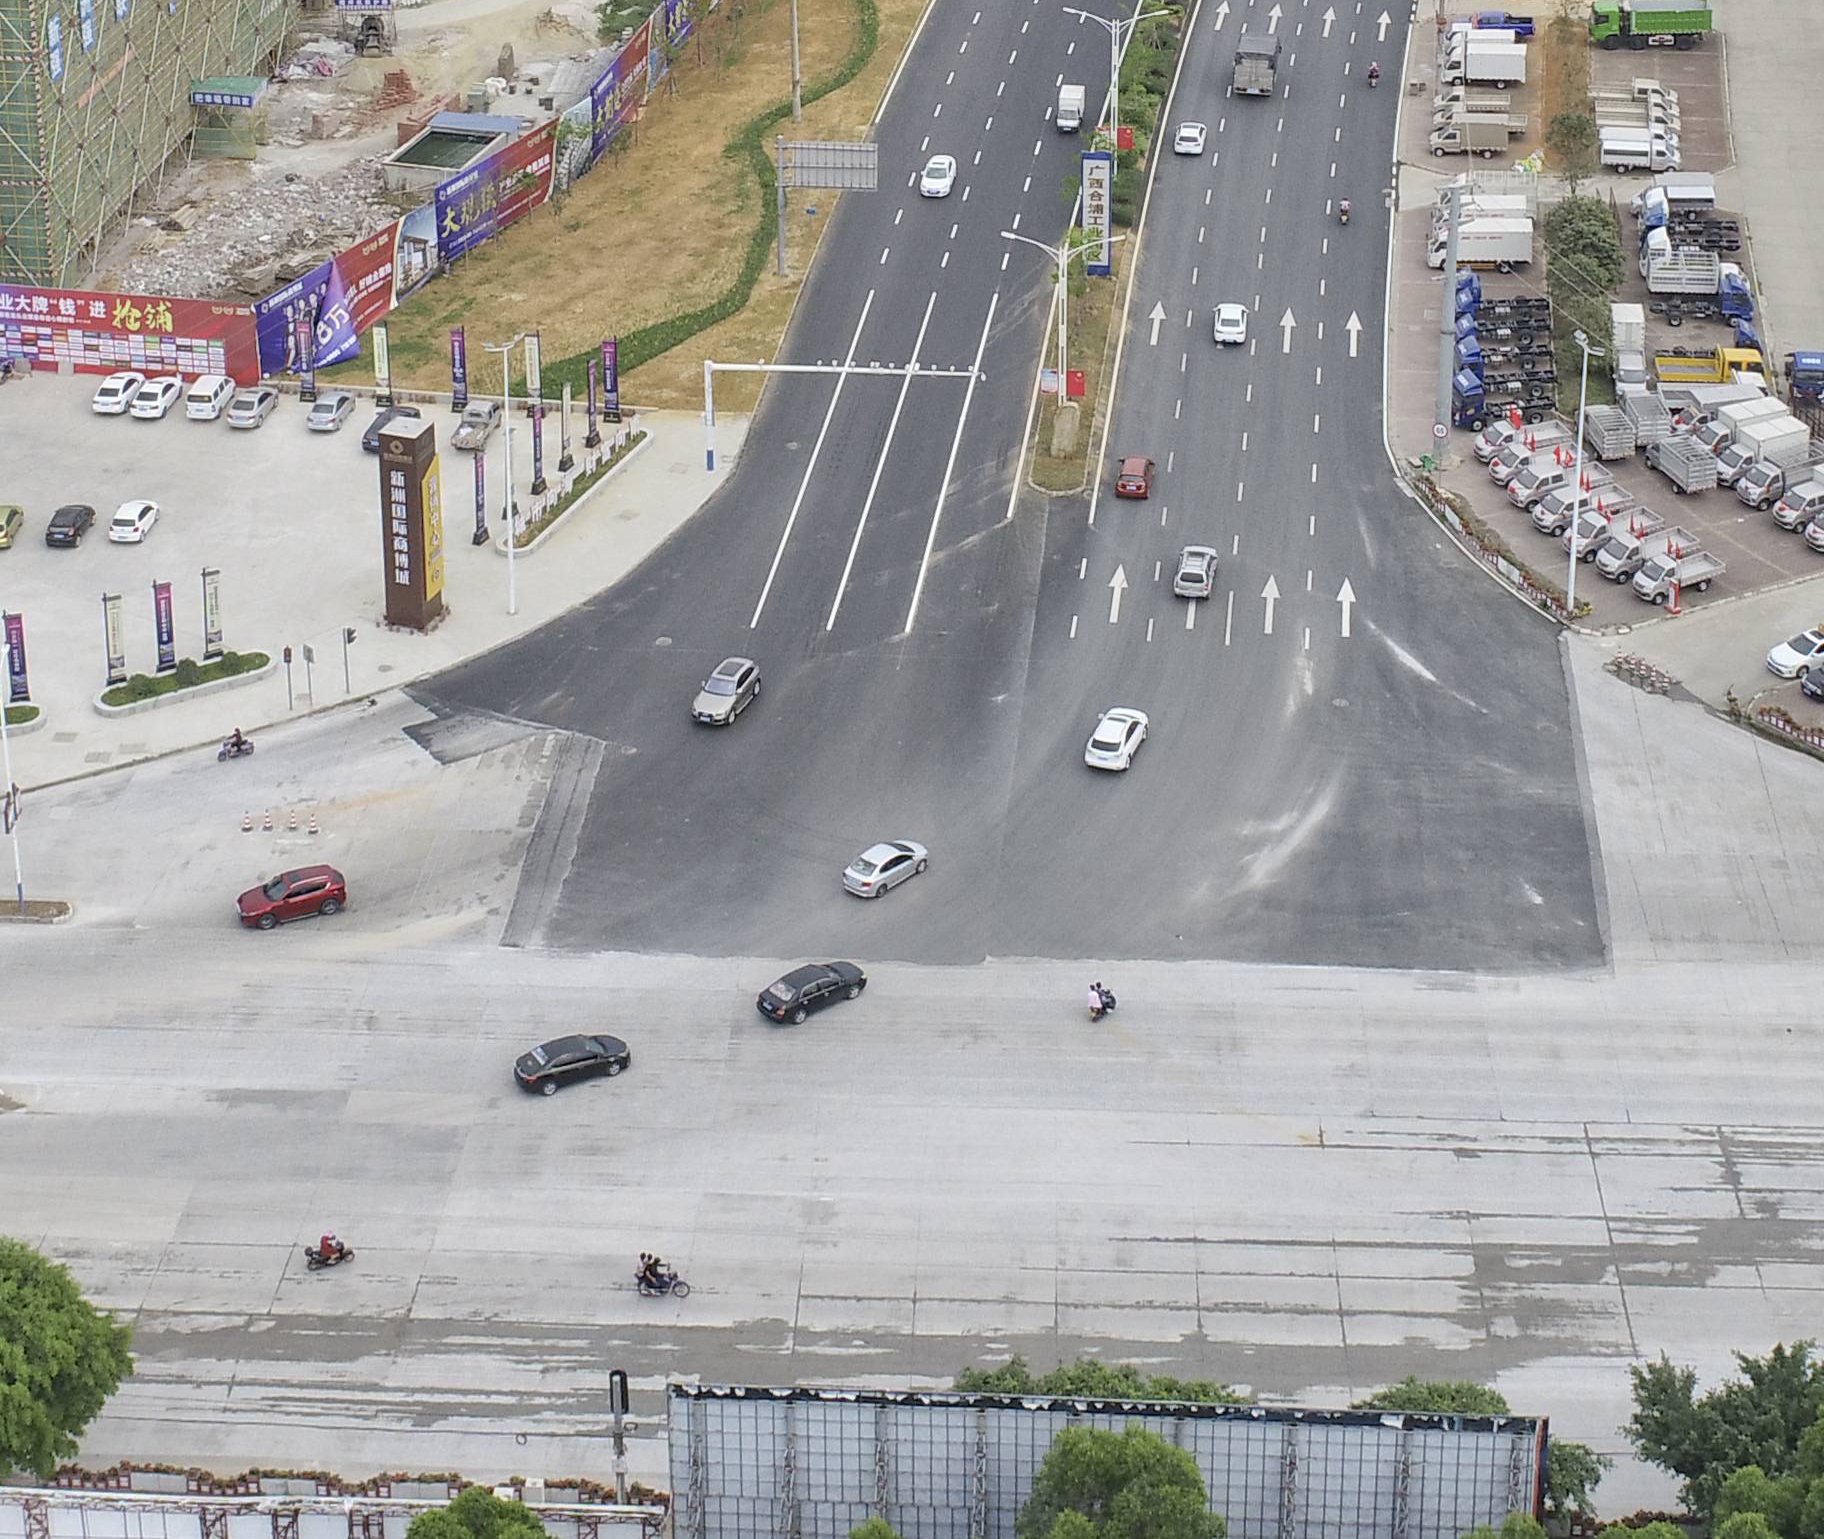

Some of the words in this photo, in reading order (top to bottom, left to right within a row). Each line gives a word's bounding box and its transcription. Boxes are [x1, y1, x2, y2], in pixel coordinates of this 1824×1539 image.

[389, 469, 410, 586] 新洲国际商博城
